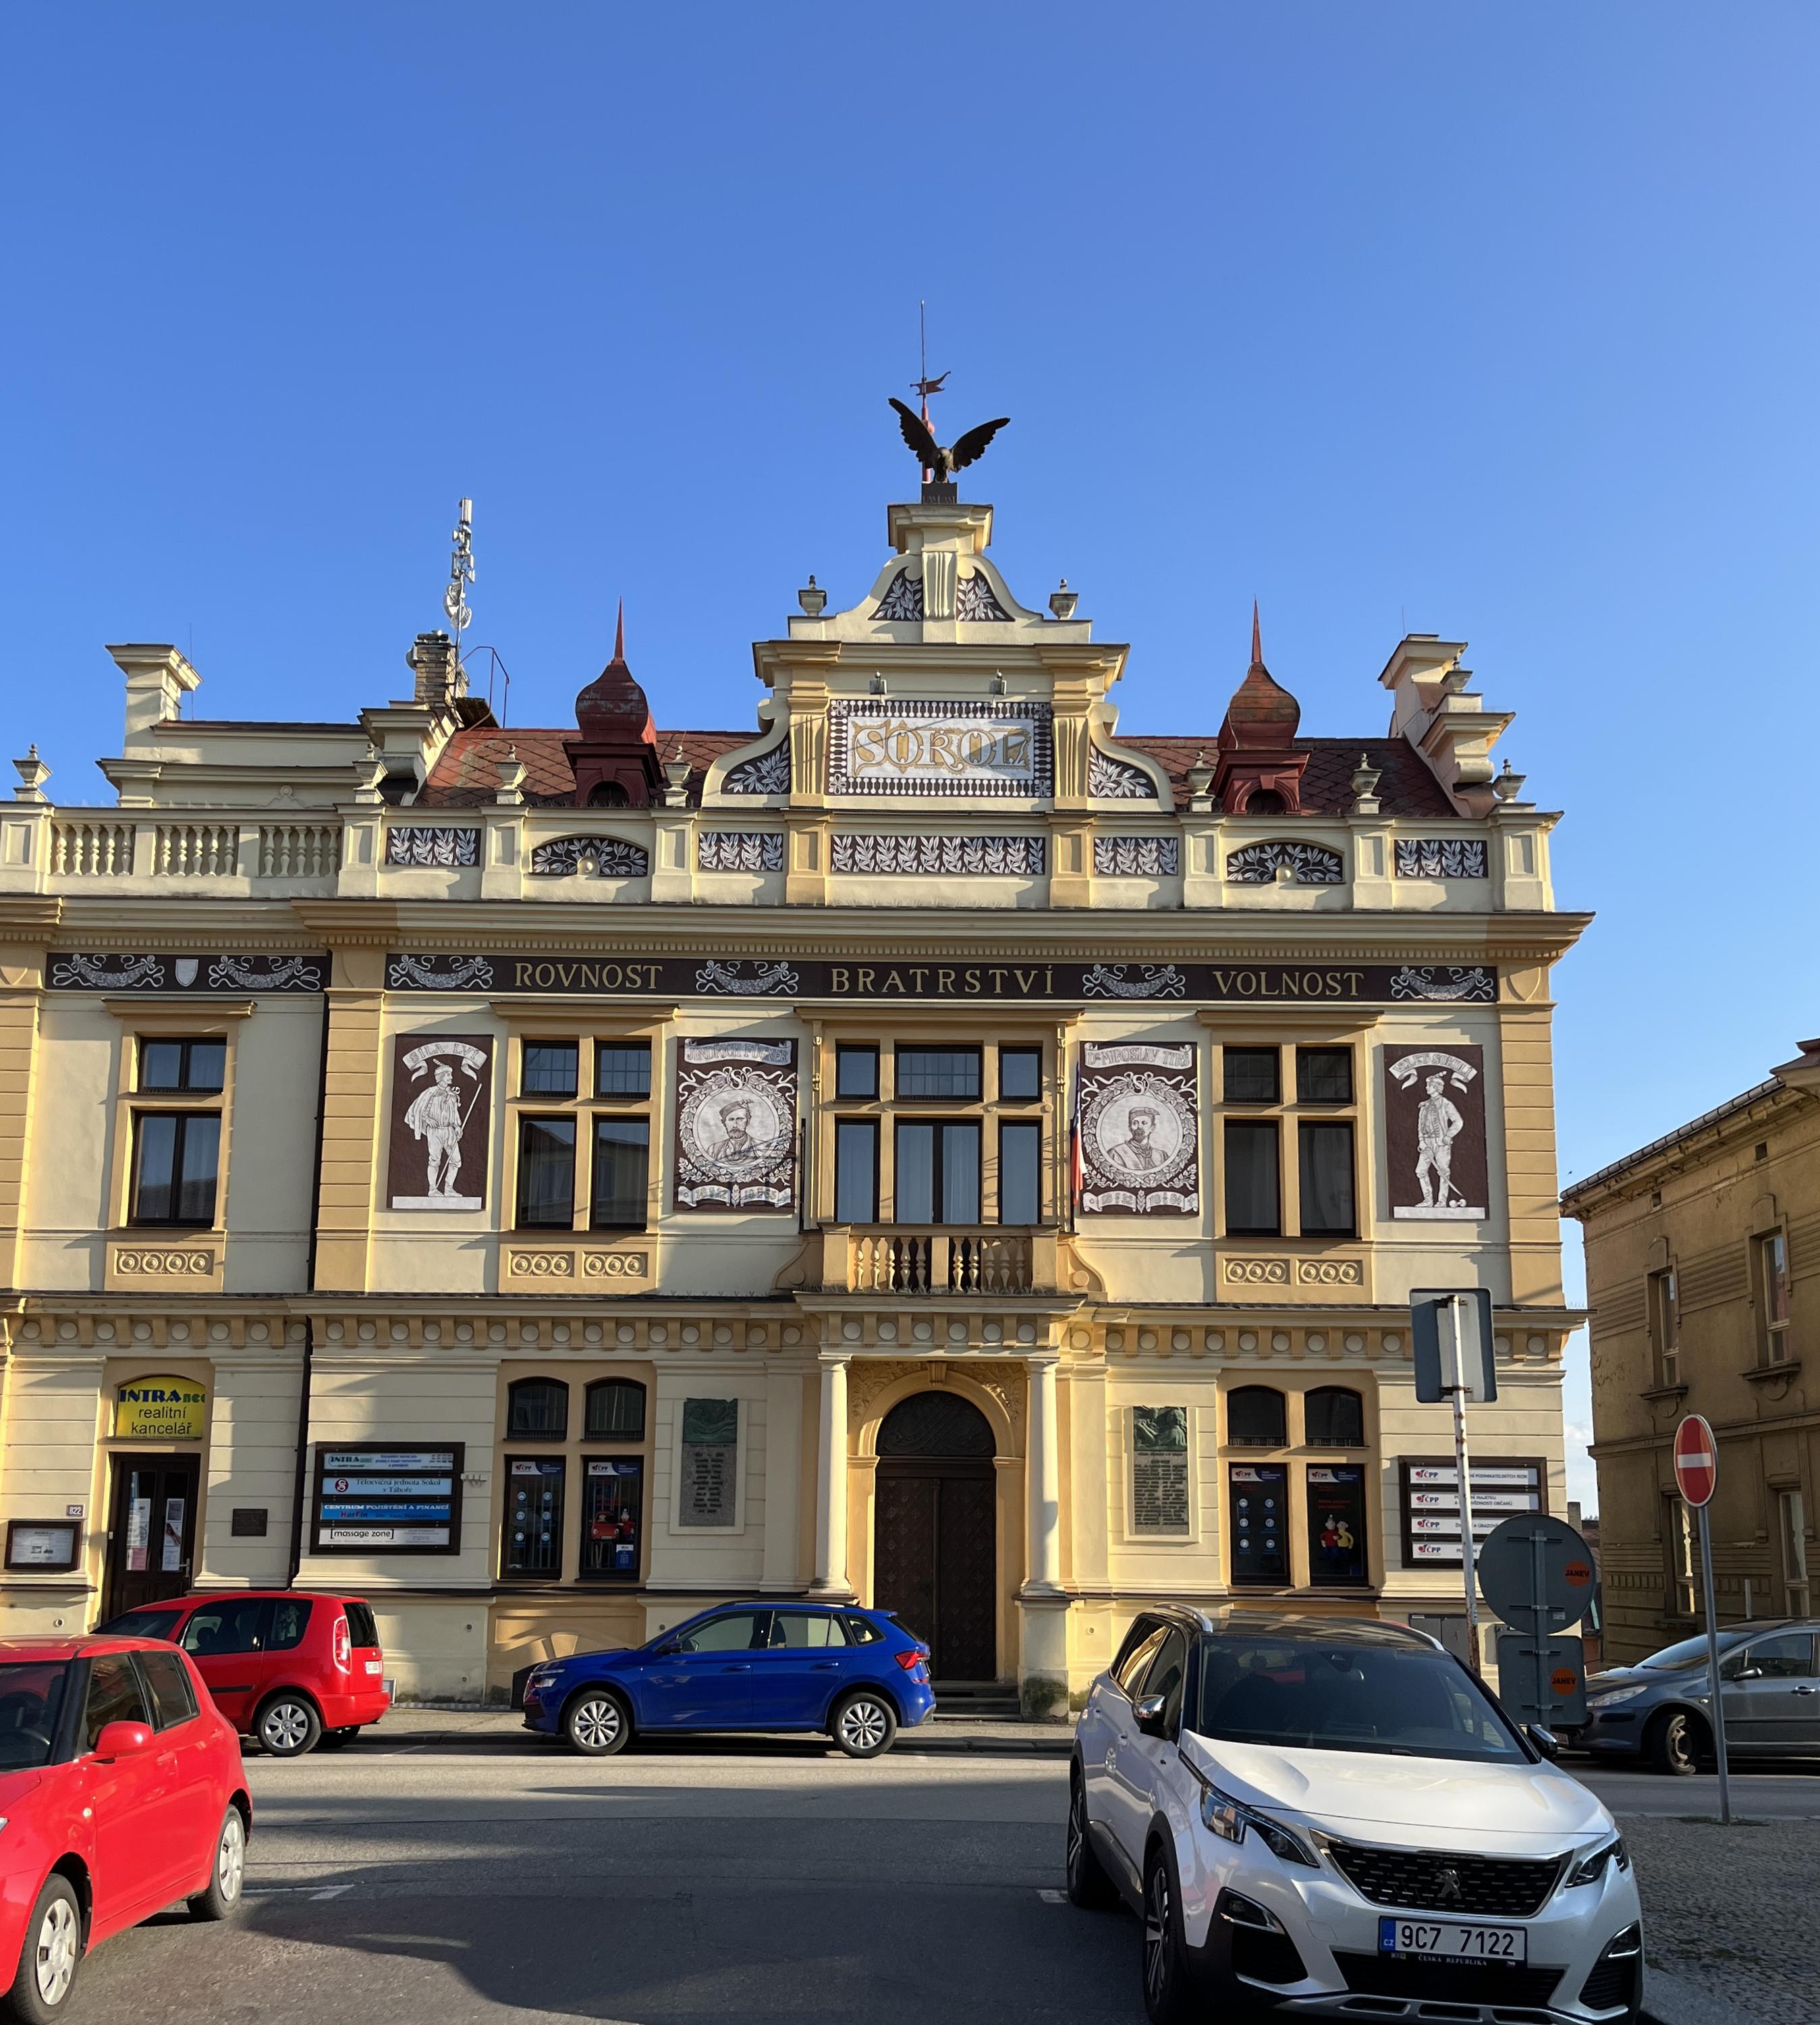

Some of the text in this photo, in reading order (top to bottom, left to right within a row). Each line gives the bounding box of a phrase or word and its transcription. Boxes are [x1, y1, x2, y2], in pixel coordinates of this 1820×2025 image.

[854, 721, 1030, 776] SOKOL
[514, 963, 663, 989] ROVNOST
[831, 965, 1054, 994] BRATRSTVÍ
[1212, 971, 1365, 996] VOLNOST
[138, 1405, 186, 1419] realitní
[131, 1422, 192, 1435] kancelář
[69, 1506, 82, 1515] 822
[1565, 1569, 1589, 1577] JANEV
[1551, 1677, 1576, 1685] JANEV
[1383, 1939, 1394, 1947] CZ
[1402, 1924, 1514, 1957] 9C7 7122
[1445, 1956, 1487, 1967] REPUBLIKA
